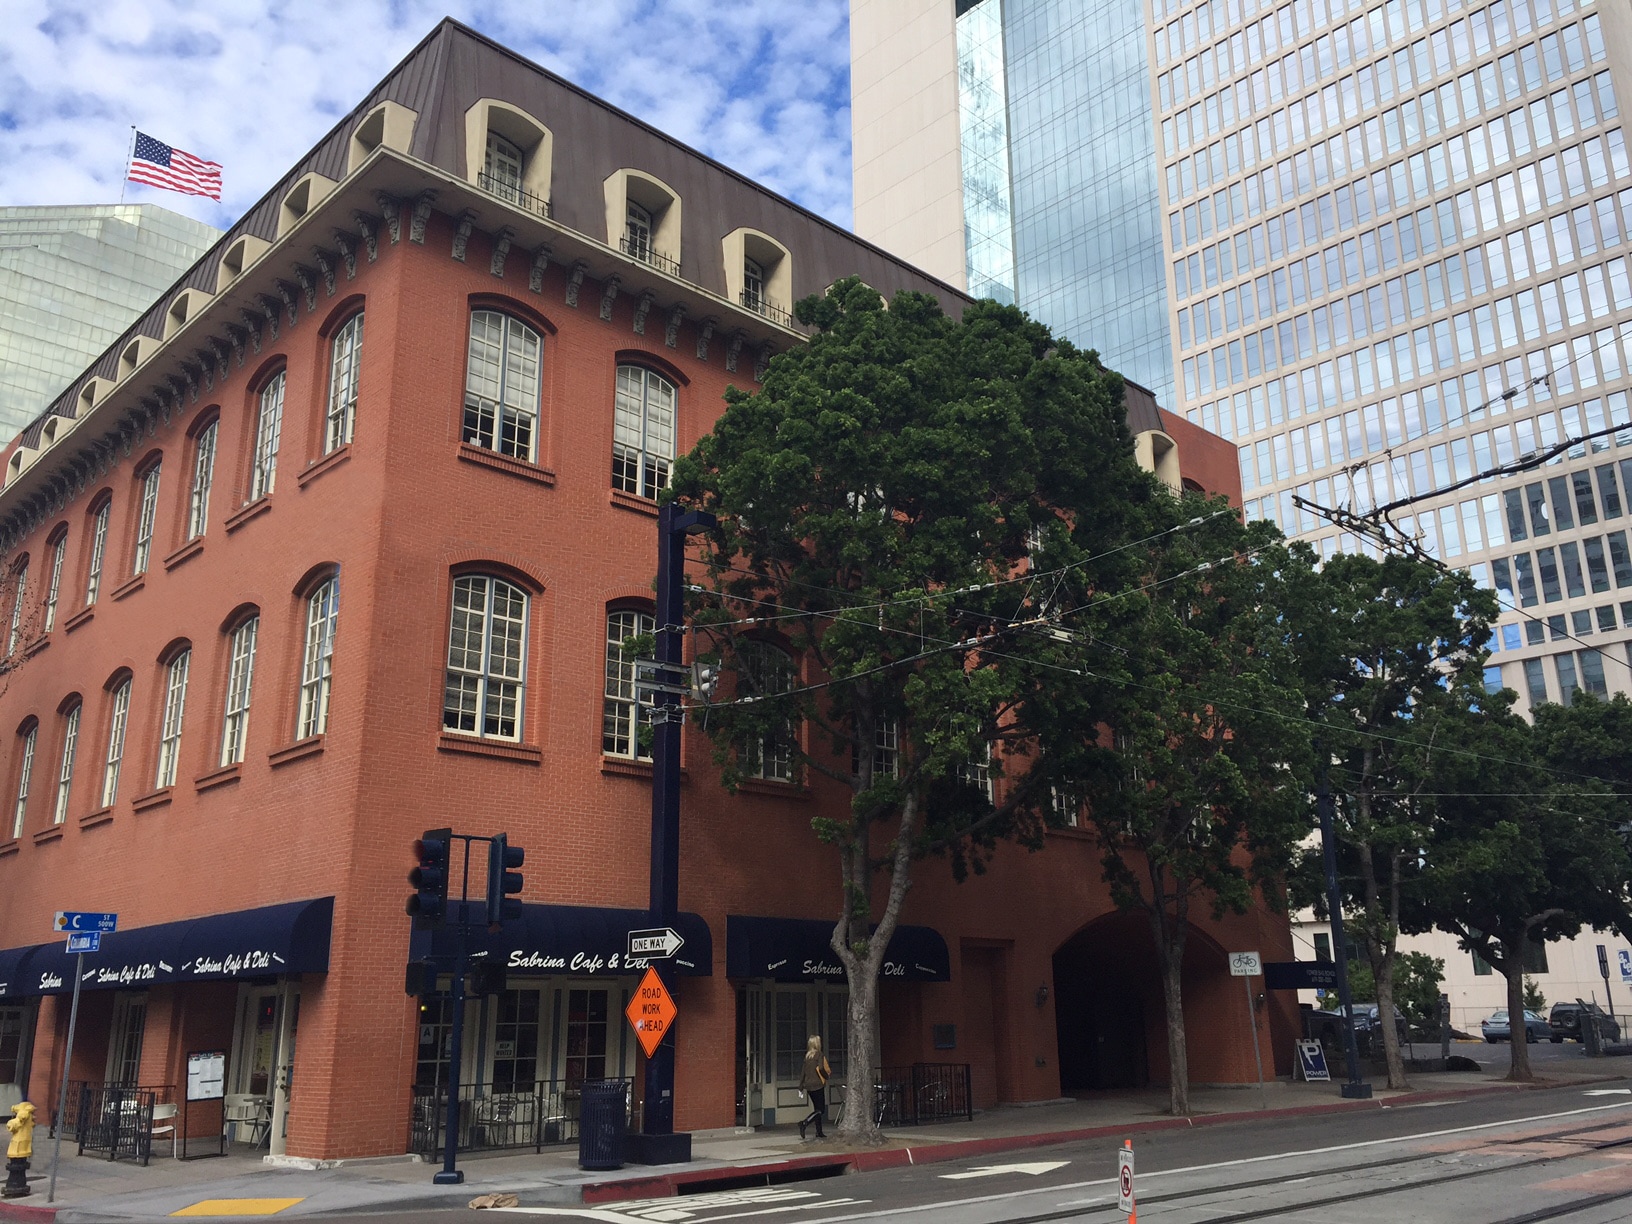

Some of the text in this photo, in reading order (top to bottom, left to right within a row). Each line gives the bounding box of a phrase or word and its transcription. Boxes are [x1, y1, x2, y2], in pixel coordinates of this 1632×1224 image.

[72, 914, 81, 928] C
[633, 938, 666, 950] ONE WAY
[193, 957, 222, 974] Sabrina
[223, 953, 242, 975] Cafe
[243, 951, 251, 969] &
[251, 950, 270, 968] Deli
[507, 950, 566, 968] Sabrina
[570, 951, 603, 973] Cafe
[607, 952, 619, 969] &
[802, 959, 844, 975] Sabrina
[883, 961, 905, 977] Deli
[38, 971, 63, 990] Sabrina
[97, 967, 120, 983] Sabrina
[119, 965, 135, 985] Cafe
[141, 963, 156, 979] Deli
[642, 988, 662, 999] ROAD
[642, 1003, 661, 1015] WORK
[423, 1027, 431, 1037] A
[638, 1019, 664, 1032] AHEAD
